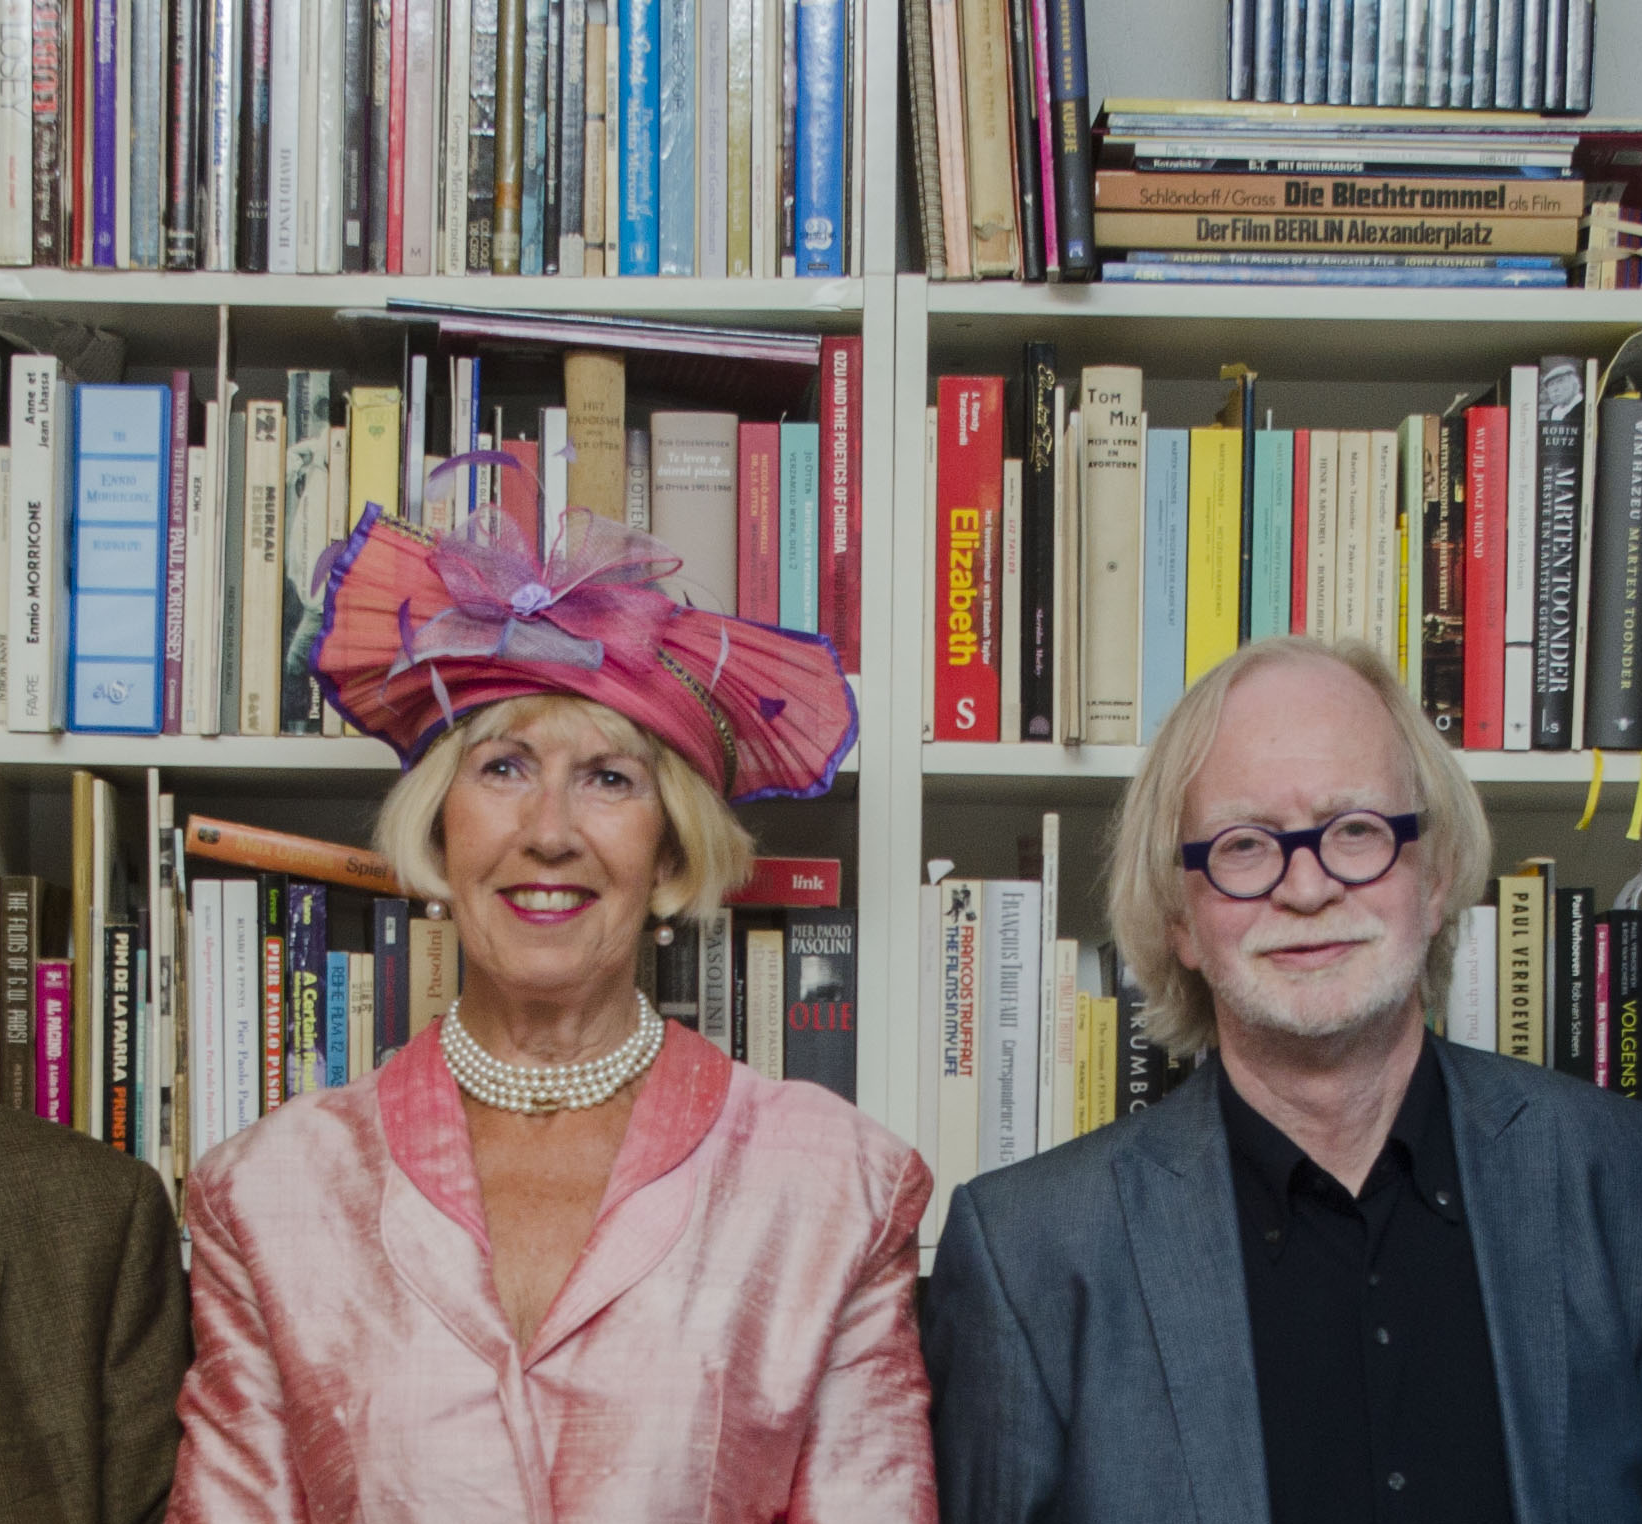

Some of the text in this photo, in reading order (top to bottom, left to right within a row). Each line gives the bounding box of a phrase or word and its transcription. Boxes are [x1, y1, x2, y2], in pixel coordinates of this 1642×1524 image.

[1061, 100, 1078, 154] KUIFJE
[276, 148, 293, 249] DAVID LYNCH
[1284, 179, 1325, 208] Die
[1331, 180, 1505, 211] Blechtrommel
[1509, 197, 1528, 212] als
[1531, 195, 1561, 213] Film
[1196, 216, 1493, 251] Der Film BERLIN Alexanderplatz
[832, 351, 847, 376] OZU
[832, 378, 847, 405] AND
[832, 406, 847, 430] THE
[832, 432, 847, 485] POETICS
[264, 485, 276, 563] MURNAU
[832, 487, 847, 504] OF
[26, 500, 42, 644] Ennio MORRICONE
[165, 527, 186, 662] PAUL MORRISSEY
[948, 508, 980, 667] Elizabeth
[1537, 466, 1553, 694] EERSTE EN LAATSTE GESPREKKEN
[1547, 467, 1575, 693] MARTEN TOONDER
[1625, 526, 1640, 599] MARTEN
[1619, 606, 1637, 691] TOONDER
[7, 891, 27, 912] THE
[7, 917, 27, 953] FILMS
[1570, 894, 1582, 976] Paul Verhoeven
[7, 957, 27, 973] OF
[959, 925, 973, 1077] FRANCOIS TRUFFAUT
[1511, 892, 1529, 1056] PAUL VERHOEVEN
[7, 1009, 27, 1045] PABST
[112, 932, 128, 1082] PIM DE LA PARRA
